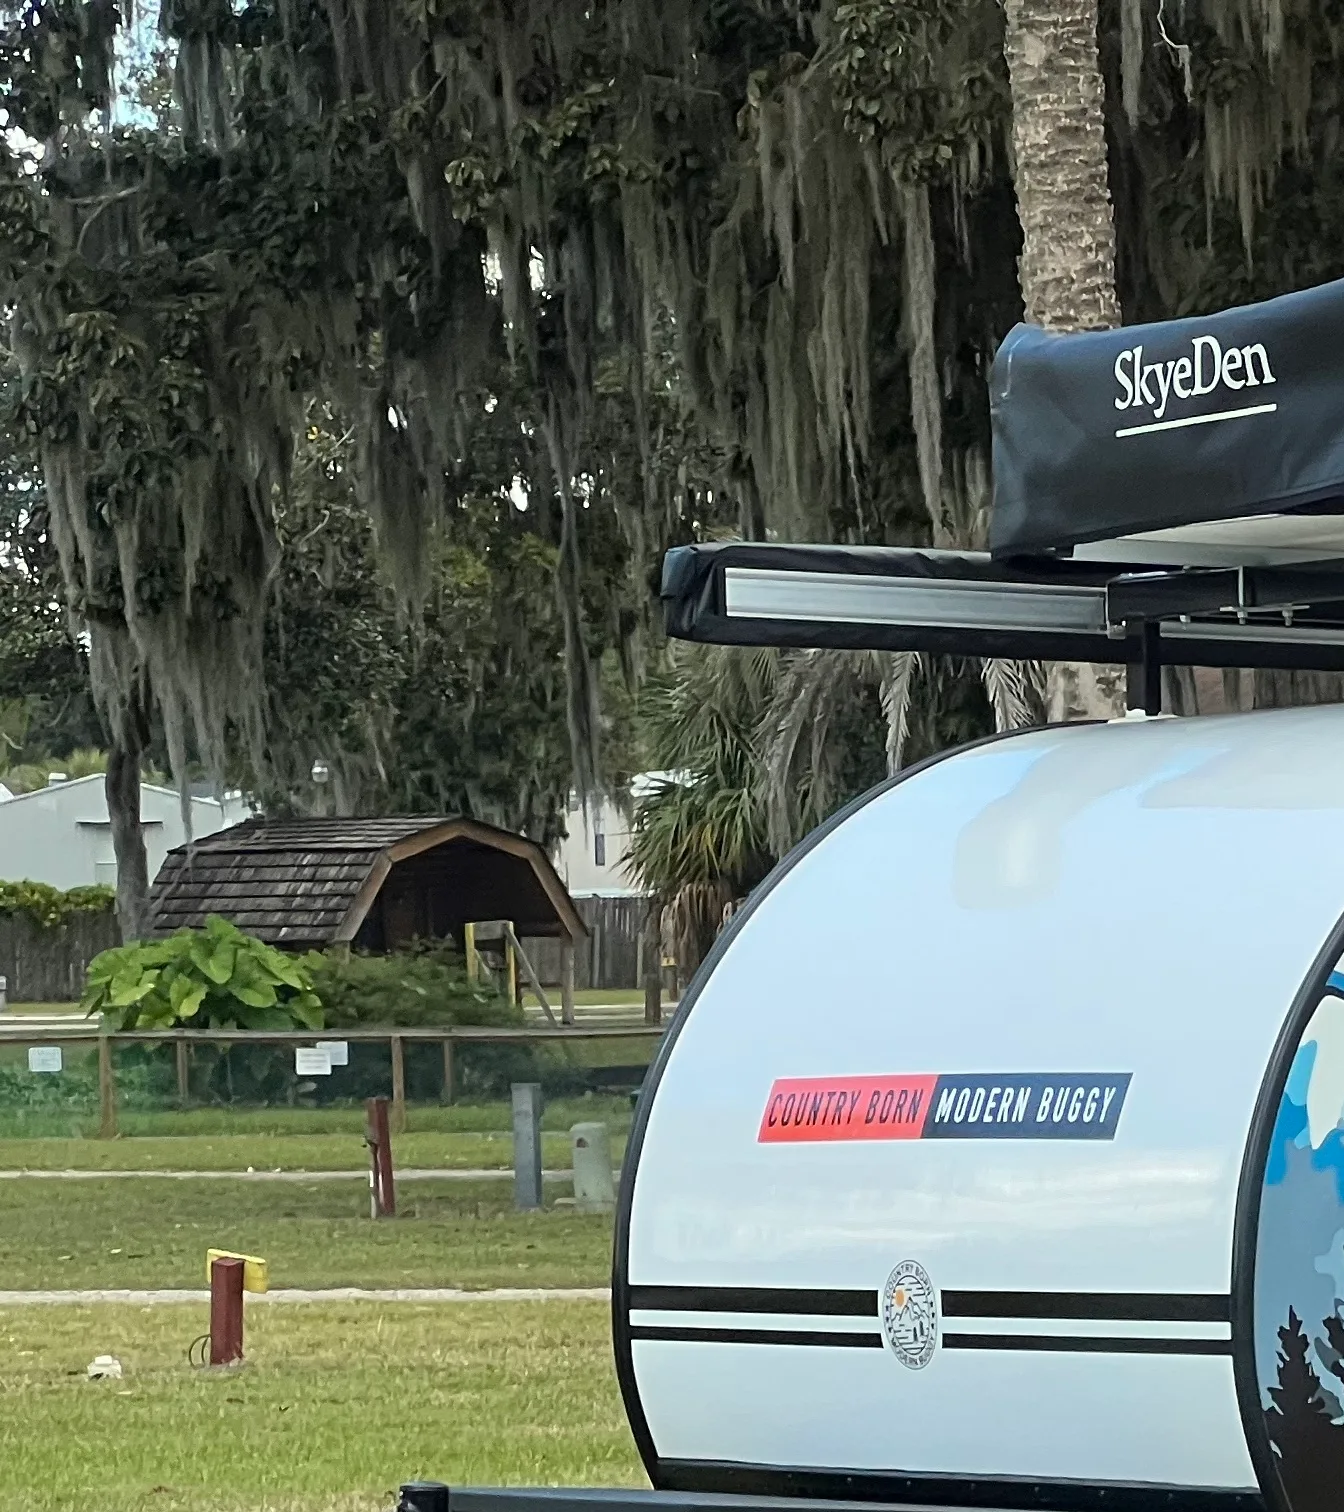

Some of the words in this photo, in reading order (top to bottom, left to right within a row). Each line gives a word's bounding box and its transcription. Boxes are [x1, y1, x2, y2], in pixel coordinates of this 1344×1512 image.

[1115, 335, 1277, 418] SkyeDen
[768, 1089, 862, 1127] COUNTRY
[864, 1088, 924, 1125] BORN
[934, 1086, 1032, 1123] MODERN
[1035, 1086, 1116, 1123] BUGGY
